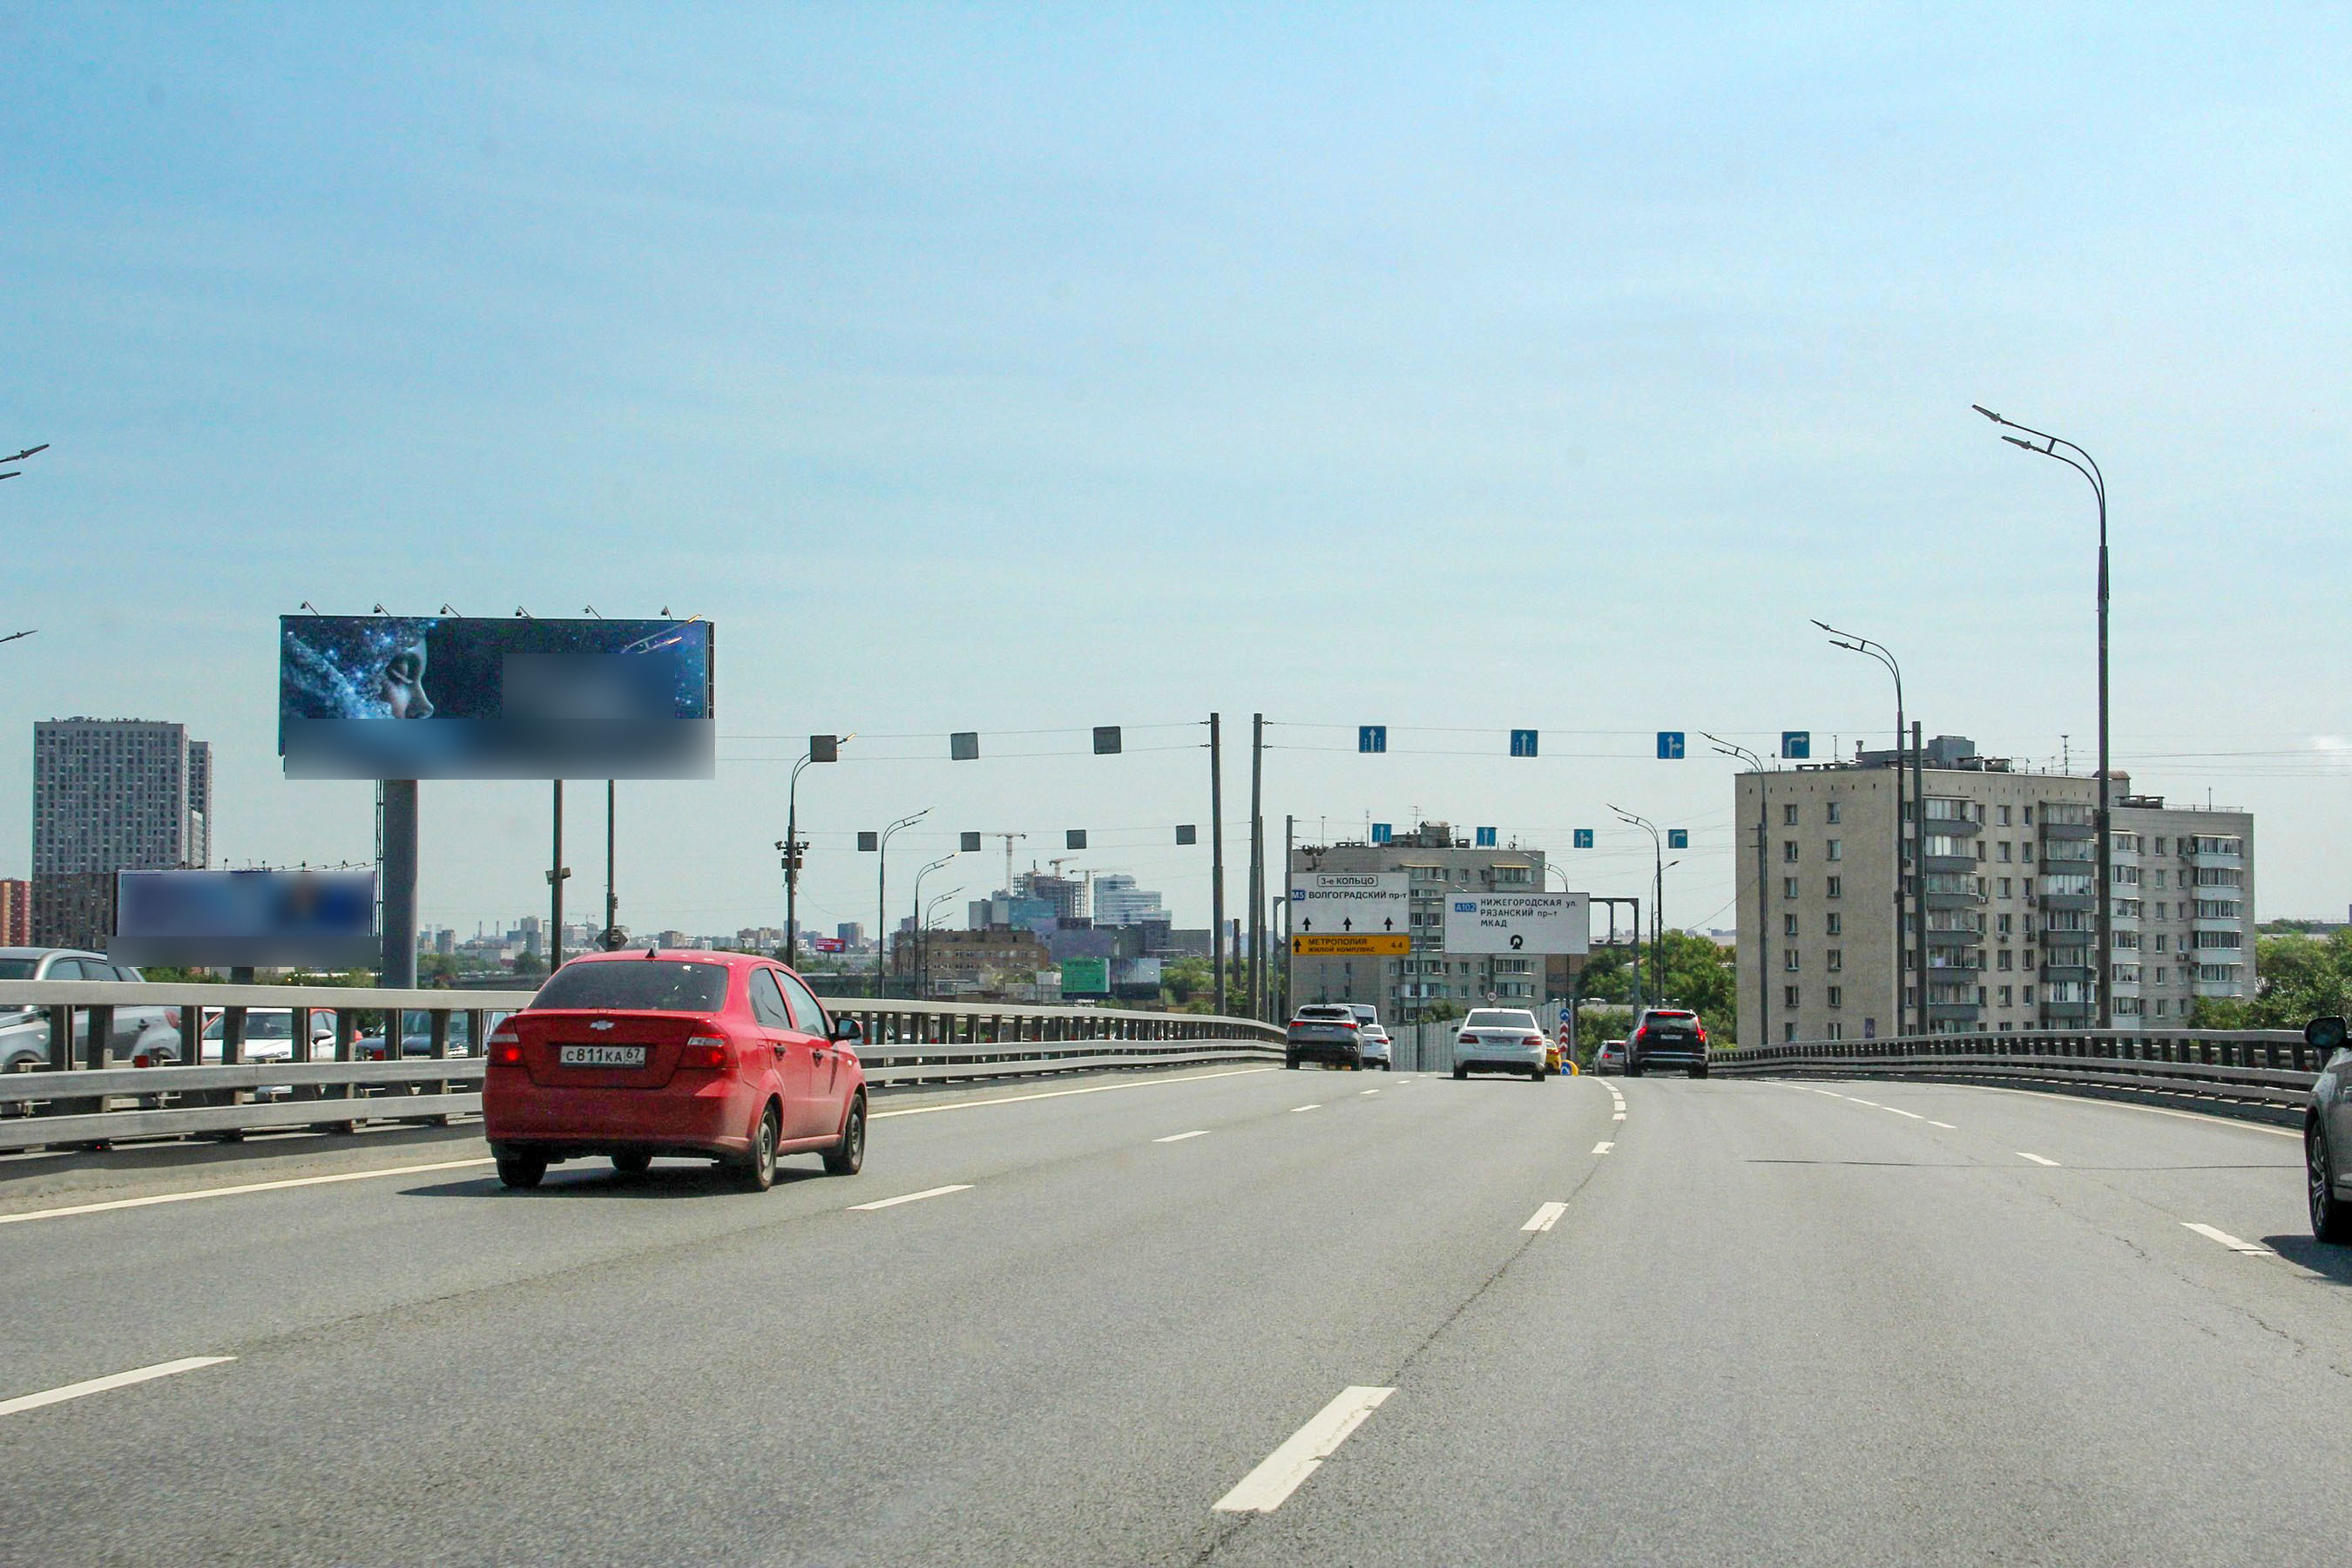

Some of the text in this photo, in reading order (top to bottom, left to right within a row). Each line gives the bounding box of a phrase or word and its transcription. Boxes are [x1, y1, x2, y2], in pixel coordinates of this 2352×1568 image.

[1336, 876, 1375, 887] КОЛЬЦО
[1308, 890, 1387, 900] ВОЛГОГРАДСКИЙ
[1389, 893, 1408, 902] пр-т
[1481, 898, 1562, 908] НИЖЕГОРОДСКАЯ
[1481, 908, 1534, 917] РЯЗАНСКИЙ
[1481, 919, 1508, 928] МКАД
